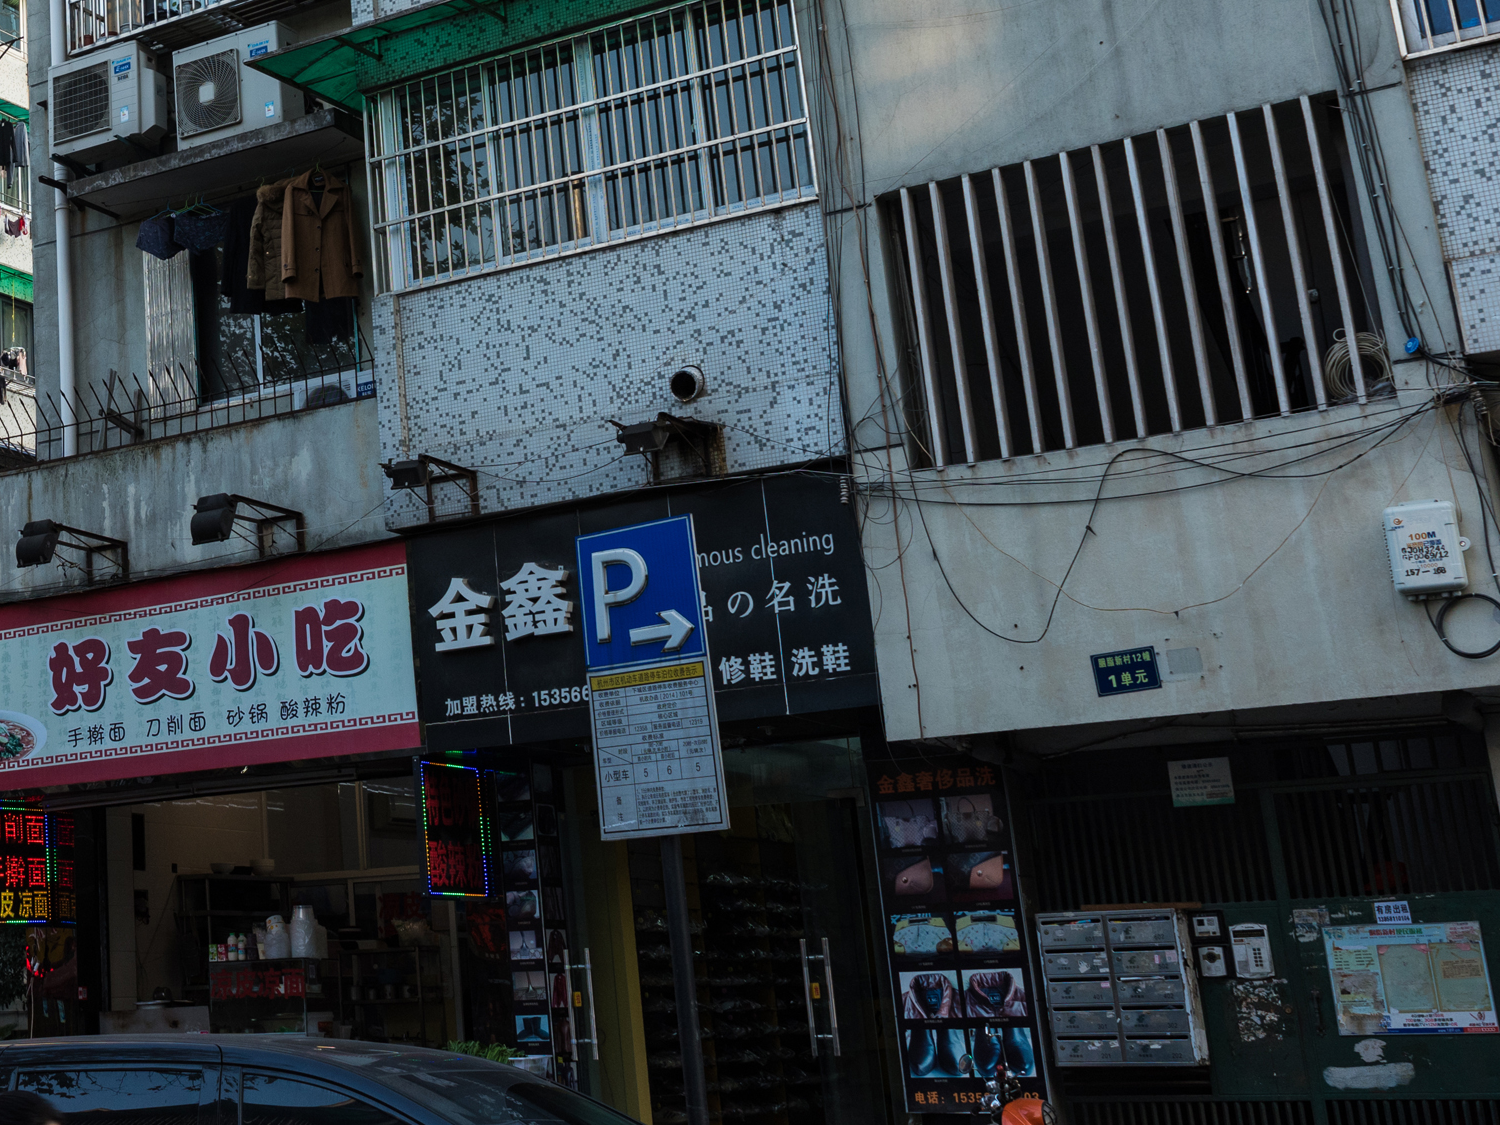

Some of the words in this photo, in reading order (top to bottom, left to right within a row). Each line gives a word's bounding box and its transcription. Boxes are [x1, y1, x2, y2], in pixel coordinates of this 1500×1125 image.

[751, 531, 835, 560] cleaning
[1408, 531, 1437, 541] 100M
[428, 562, 576, 653] 金鑫
[590, 547, 649, 644] P
[48, 598, 370, 715] 好友小吃
[718, 651, 777, 685] 修鞋
[790, 642, 851, 677] 洗鞋
[1108, 669, 1149, 688] 1单元
[67, 721, 126, 748] 手擀面
[145, 711, 207, 738] 刀削面
[226, 706, 269, 727] 砂锅
[279, 692, 346, 721] 酸辣粉
[605, 769, 630, 783] 小型车
[643, 768, 649, 777] 5
[667, 765, 672, 775] 6
[695, 762, 701, 772] 5
[19, 889, 48, 918] 凉面
[1375, 904, 1409, 914] 有房出租
